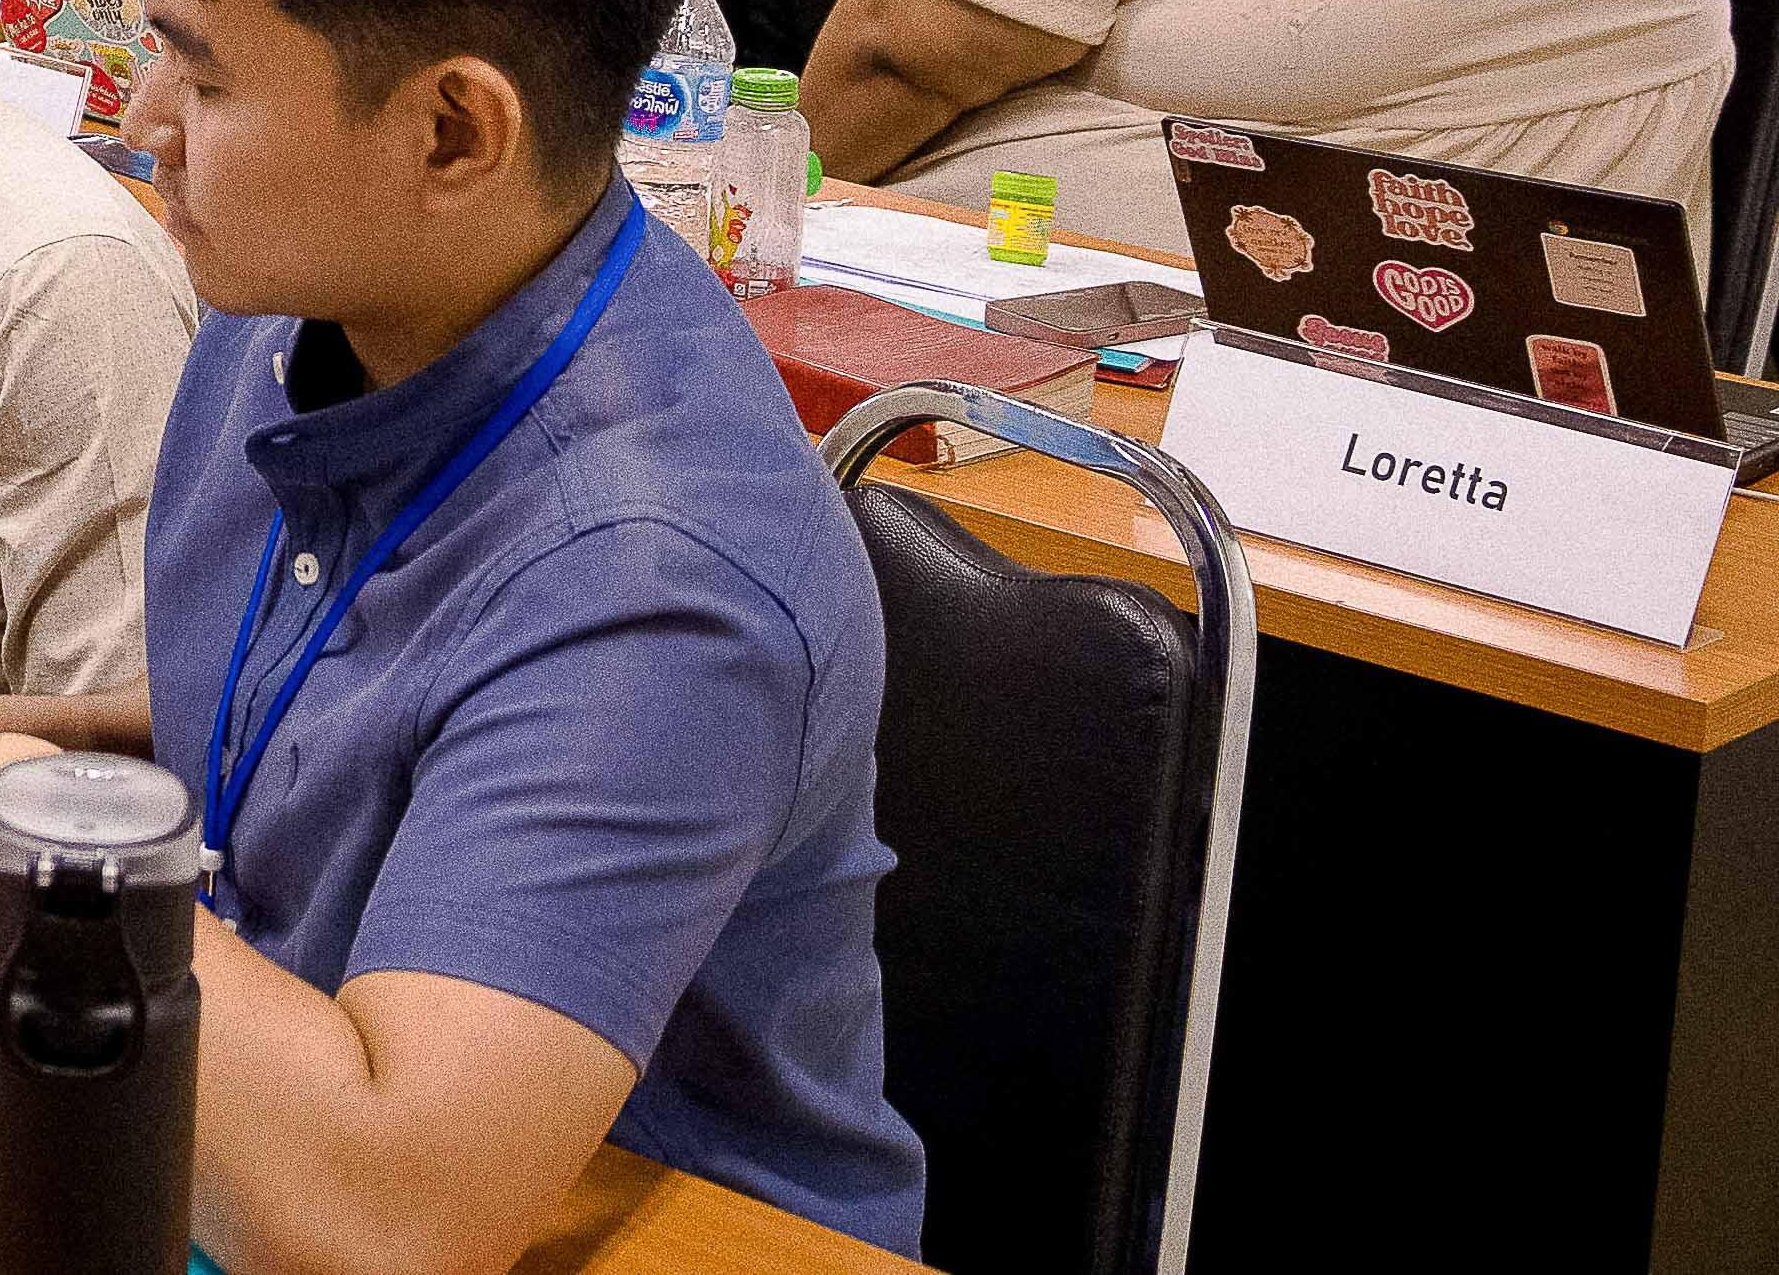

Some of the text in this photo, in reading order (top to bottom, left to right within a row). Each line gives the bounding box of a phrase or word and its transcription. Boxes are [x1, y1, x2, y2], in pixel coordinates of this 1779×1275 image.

[93, 7, 126, 28] only
[1372, 171, 1465, 208] faith
[1373, 189, 1470, 228] hope
[1341, 433, 1508, 512] Loretta
